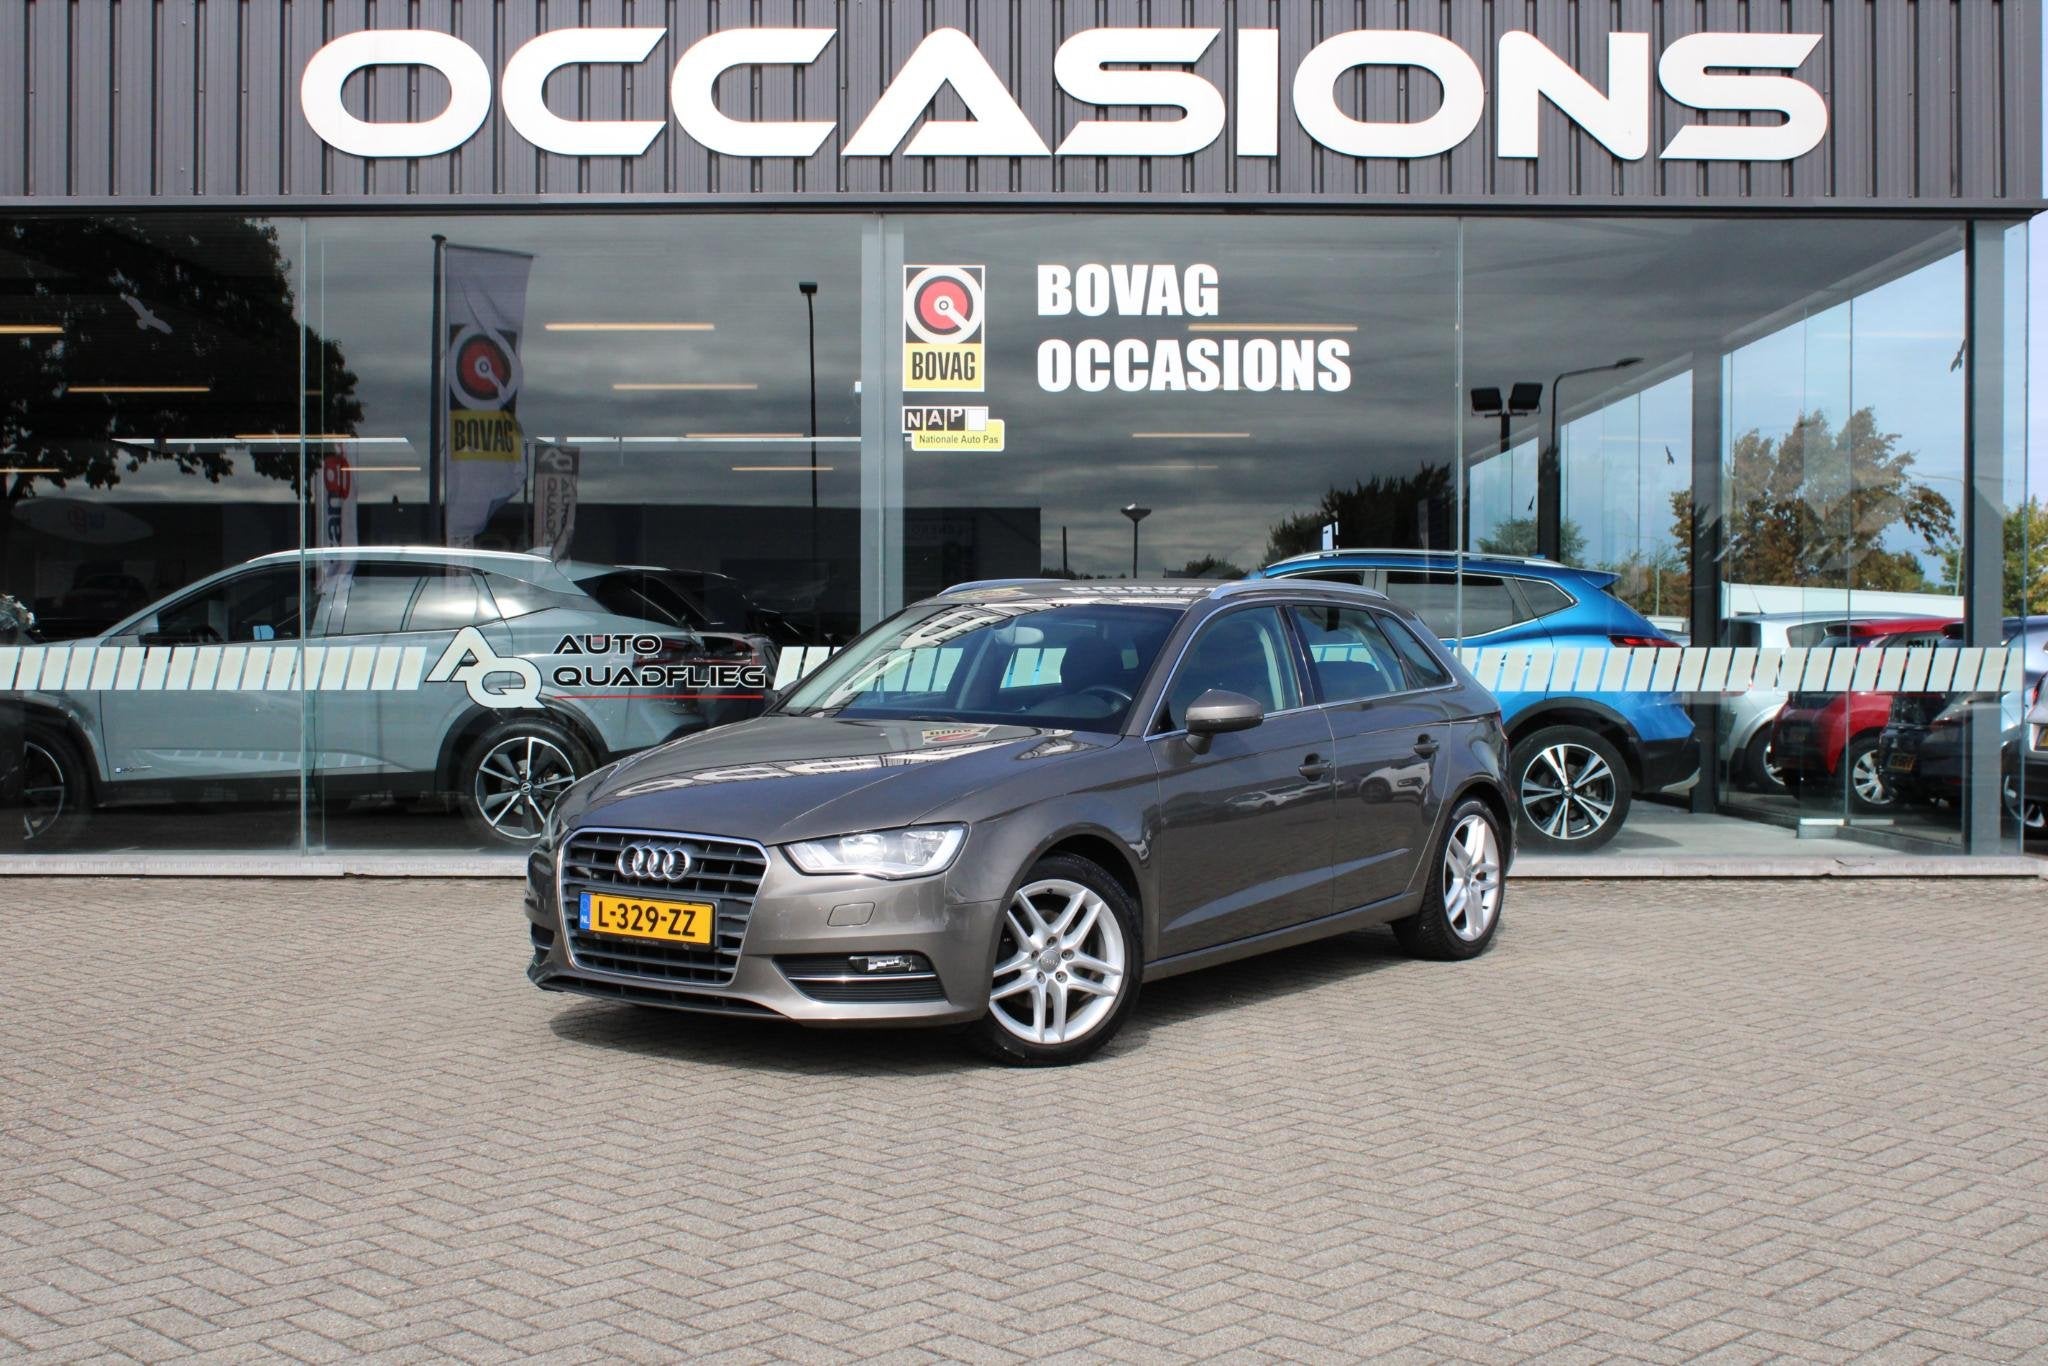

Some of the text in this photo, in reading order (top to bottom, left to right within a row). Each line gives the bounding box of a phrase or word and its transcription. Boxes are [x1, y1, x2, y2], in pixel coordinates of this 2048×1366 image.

[300, 26, 1829, 163] OCCASIONS
[1036, 262, 1219, 317] BOVAG
[911, 350, 976, 382] BOVAG
[1036, 337, 1352, 393] OCCASIONS
[453, 417, 517, 454] BOVAG
[905, 408, 964, 429] NAP
[919, 435, 999, 444] Nationale Auto Pas
[552, 633, 663, 655] AUTO
[424, 624, 546, 709] AQ
[552, 664, 767, 688] QUADFLIEG
[597, 900, 697, 937] L-329-ZZ
